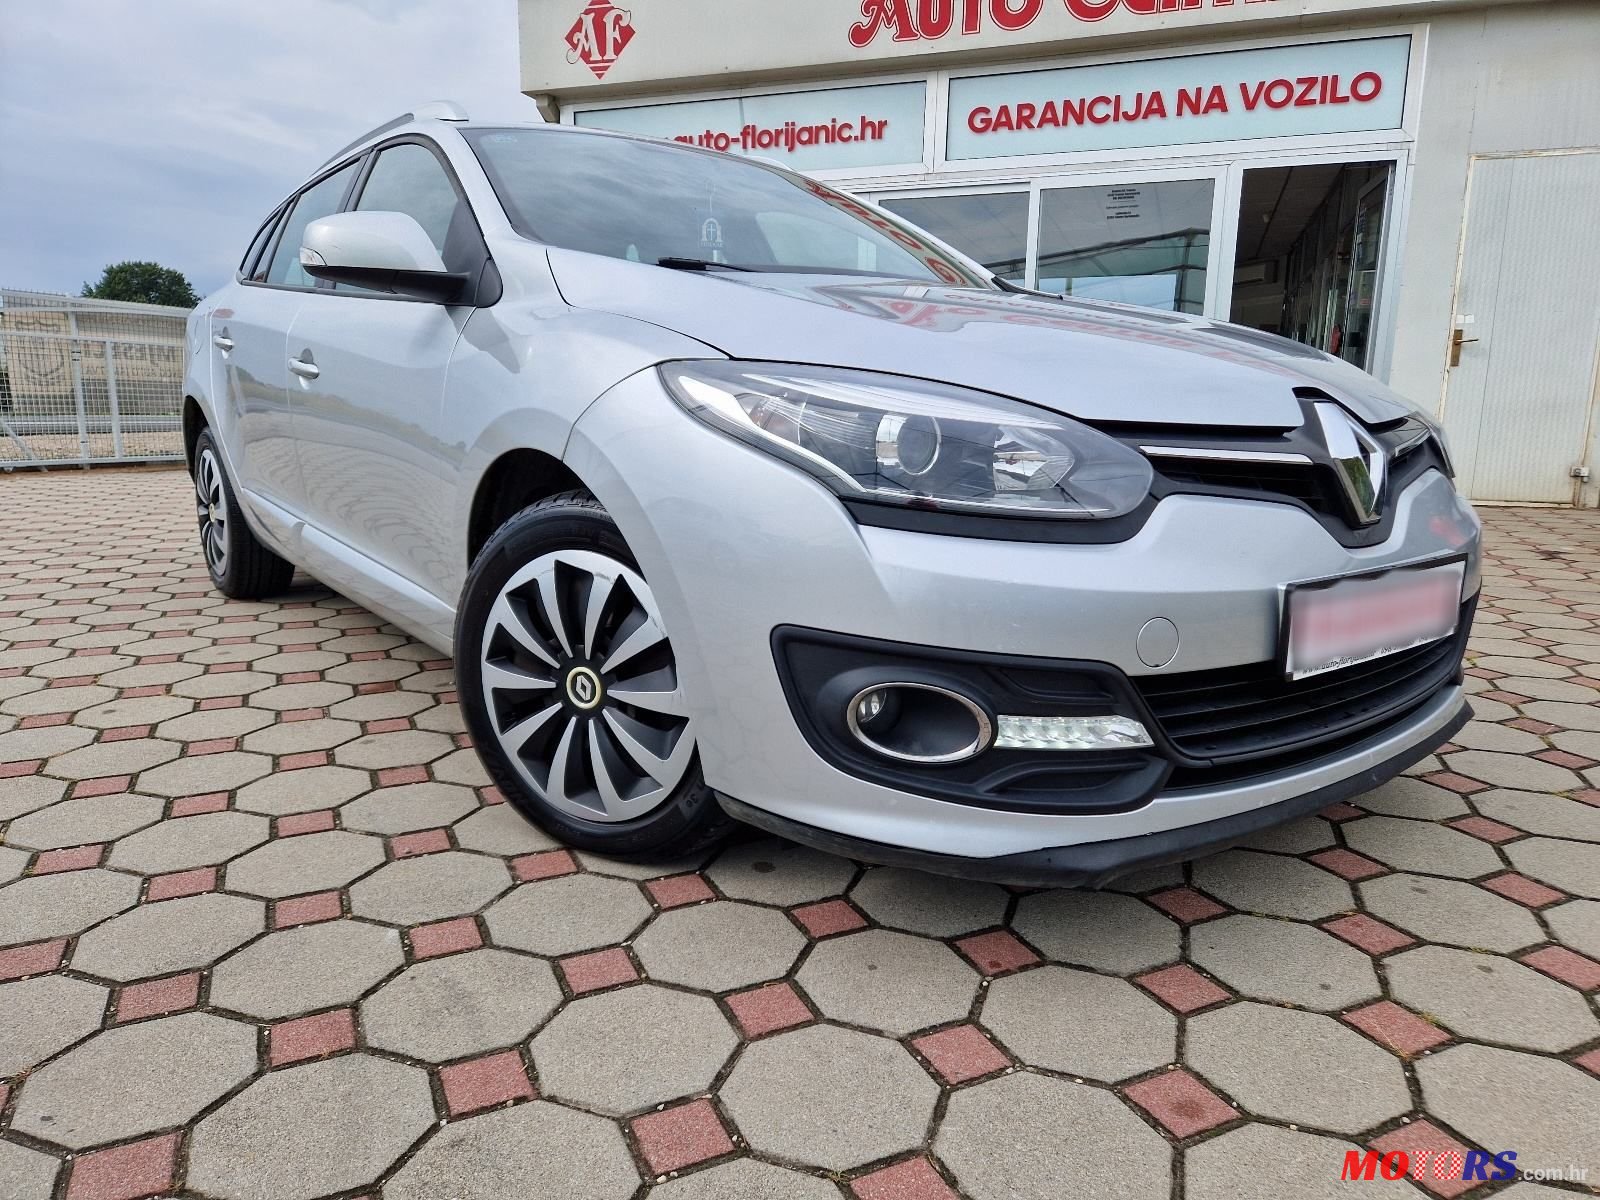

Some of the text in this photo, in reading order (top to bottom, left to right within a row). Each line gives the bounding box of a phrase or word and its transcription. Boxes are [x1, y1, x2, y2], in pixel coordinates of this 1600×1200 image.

[967, 71, 1383, 134] GARANCIJA NA VOZILO
